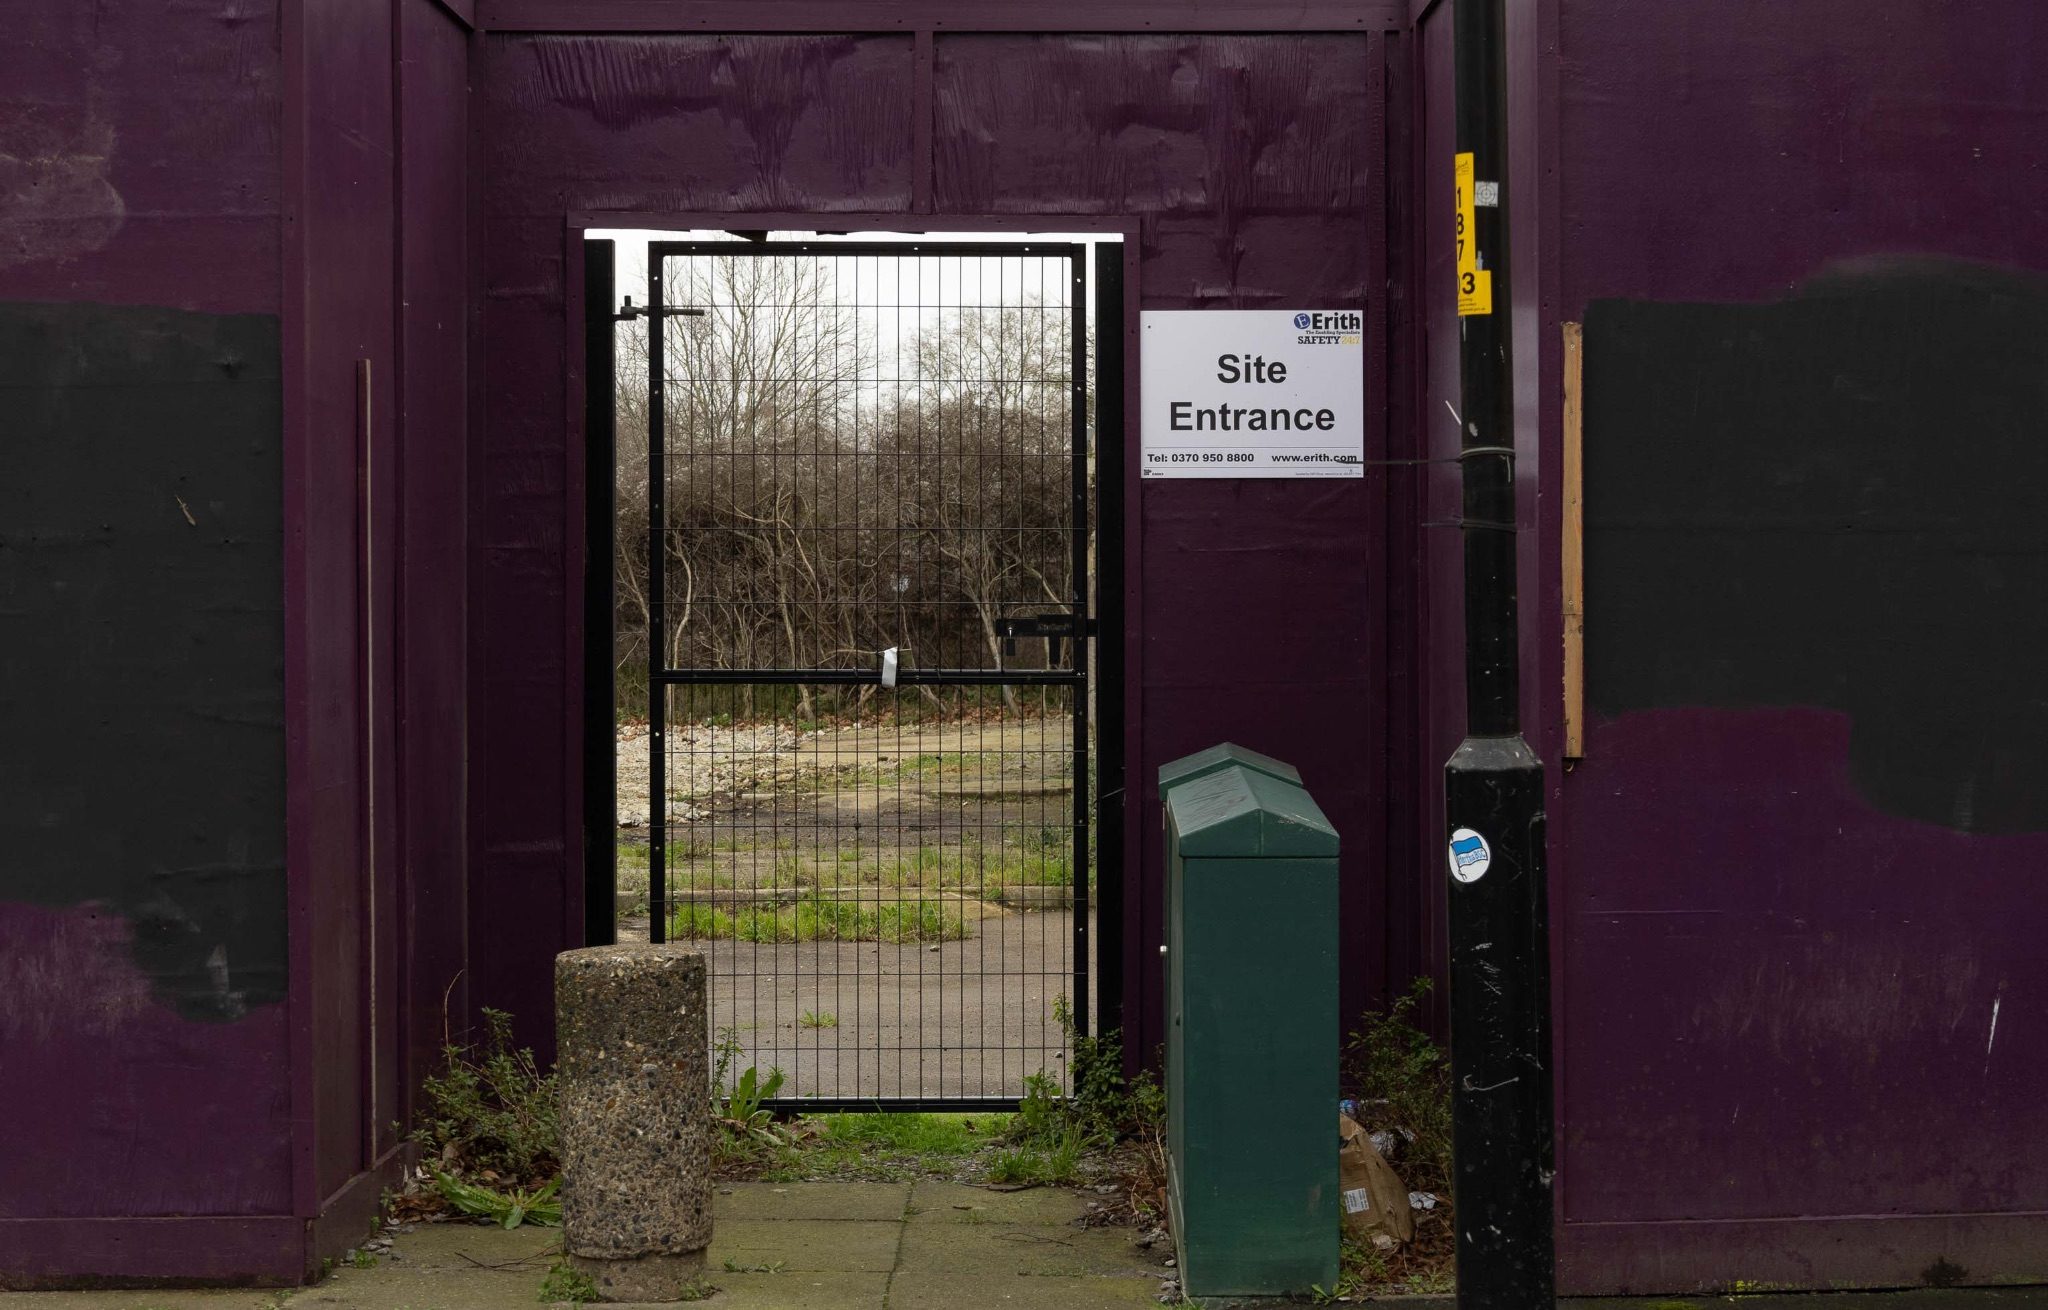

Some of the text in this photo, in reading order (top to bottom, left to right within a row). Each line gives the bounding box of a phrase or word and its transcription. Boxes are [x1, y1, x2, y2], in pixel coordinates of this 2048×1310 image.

[1457, 272, 1476, 295] 3
[1312, 312, 1361, 330] Erith
[1298, 336, 1341, 345] SAFETY
[1217, 354, 1287, 384] Site
[1170, 401, 1335, 431] Entrance
[1147, 453, 1358, 463] Tel: 0370 950 8800 www.erith.com
